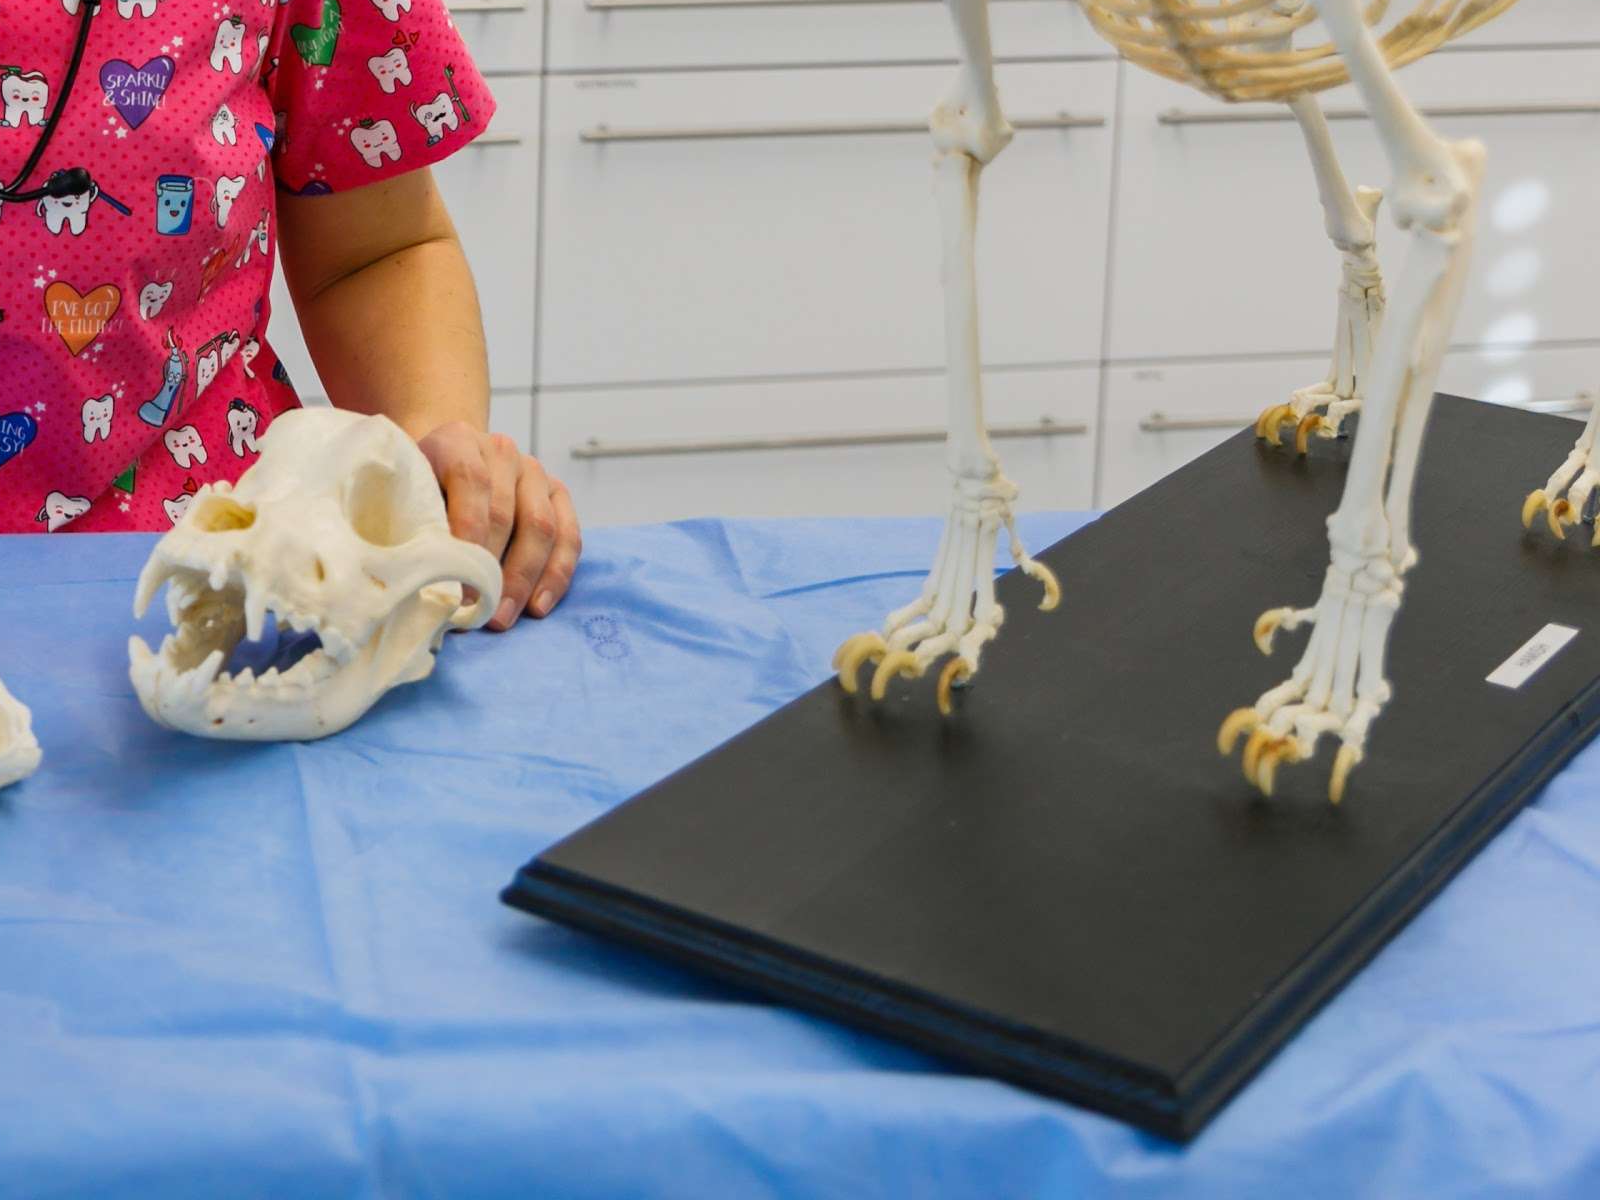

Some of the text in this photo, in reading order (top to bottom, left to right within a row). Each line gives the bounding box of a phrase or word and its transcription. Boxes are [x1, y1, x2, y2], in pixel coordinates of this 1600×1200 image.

[105, 70, 167, 91] SPARKLE
[102, 88, 167, 110] & SHINE!
[52, 300, 112, 317] I'VE GOT
